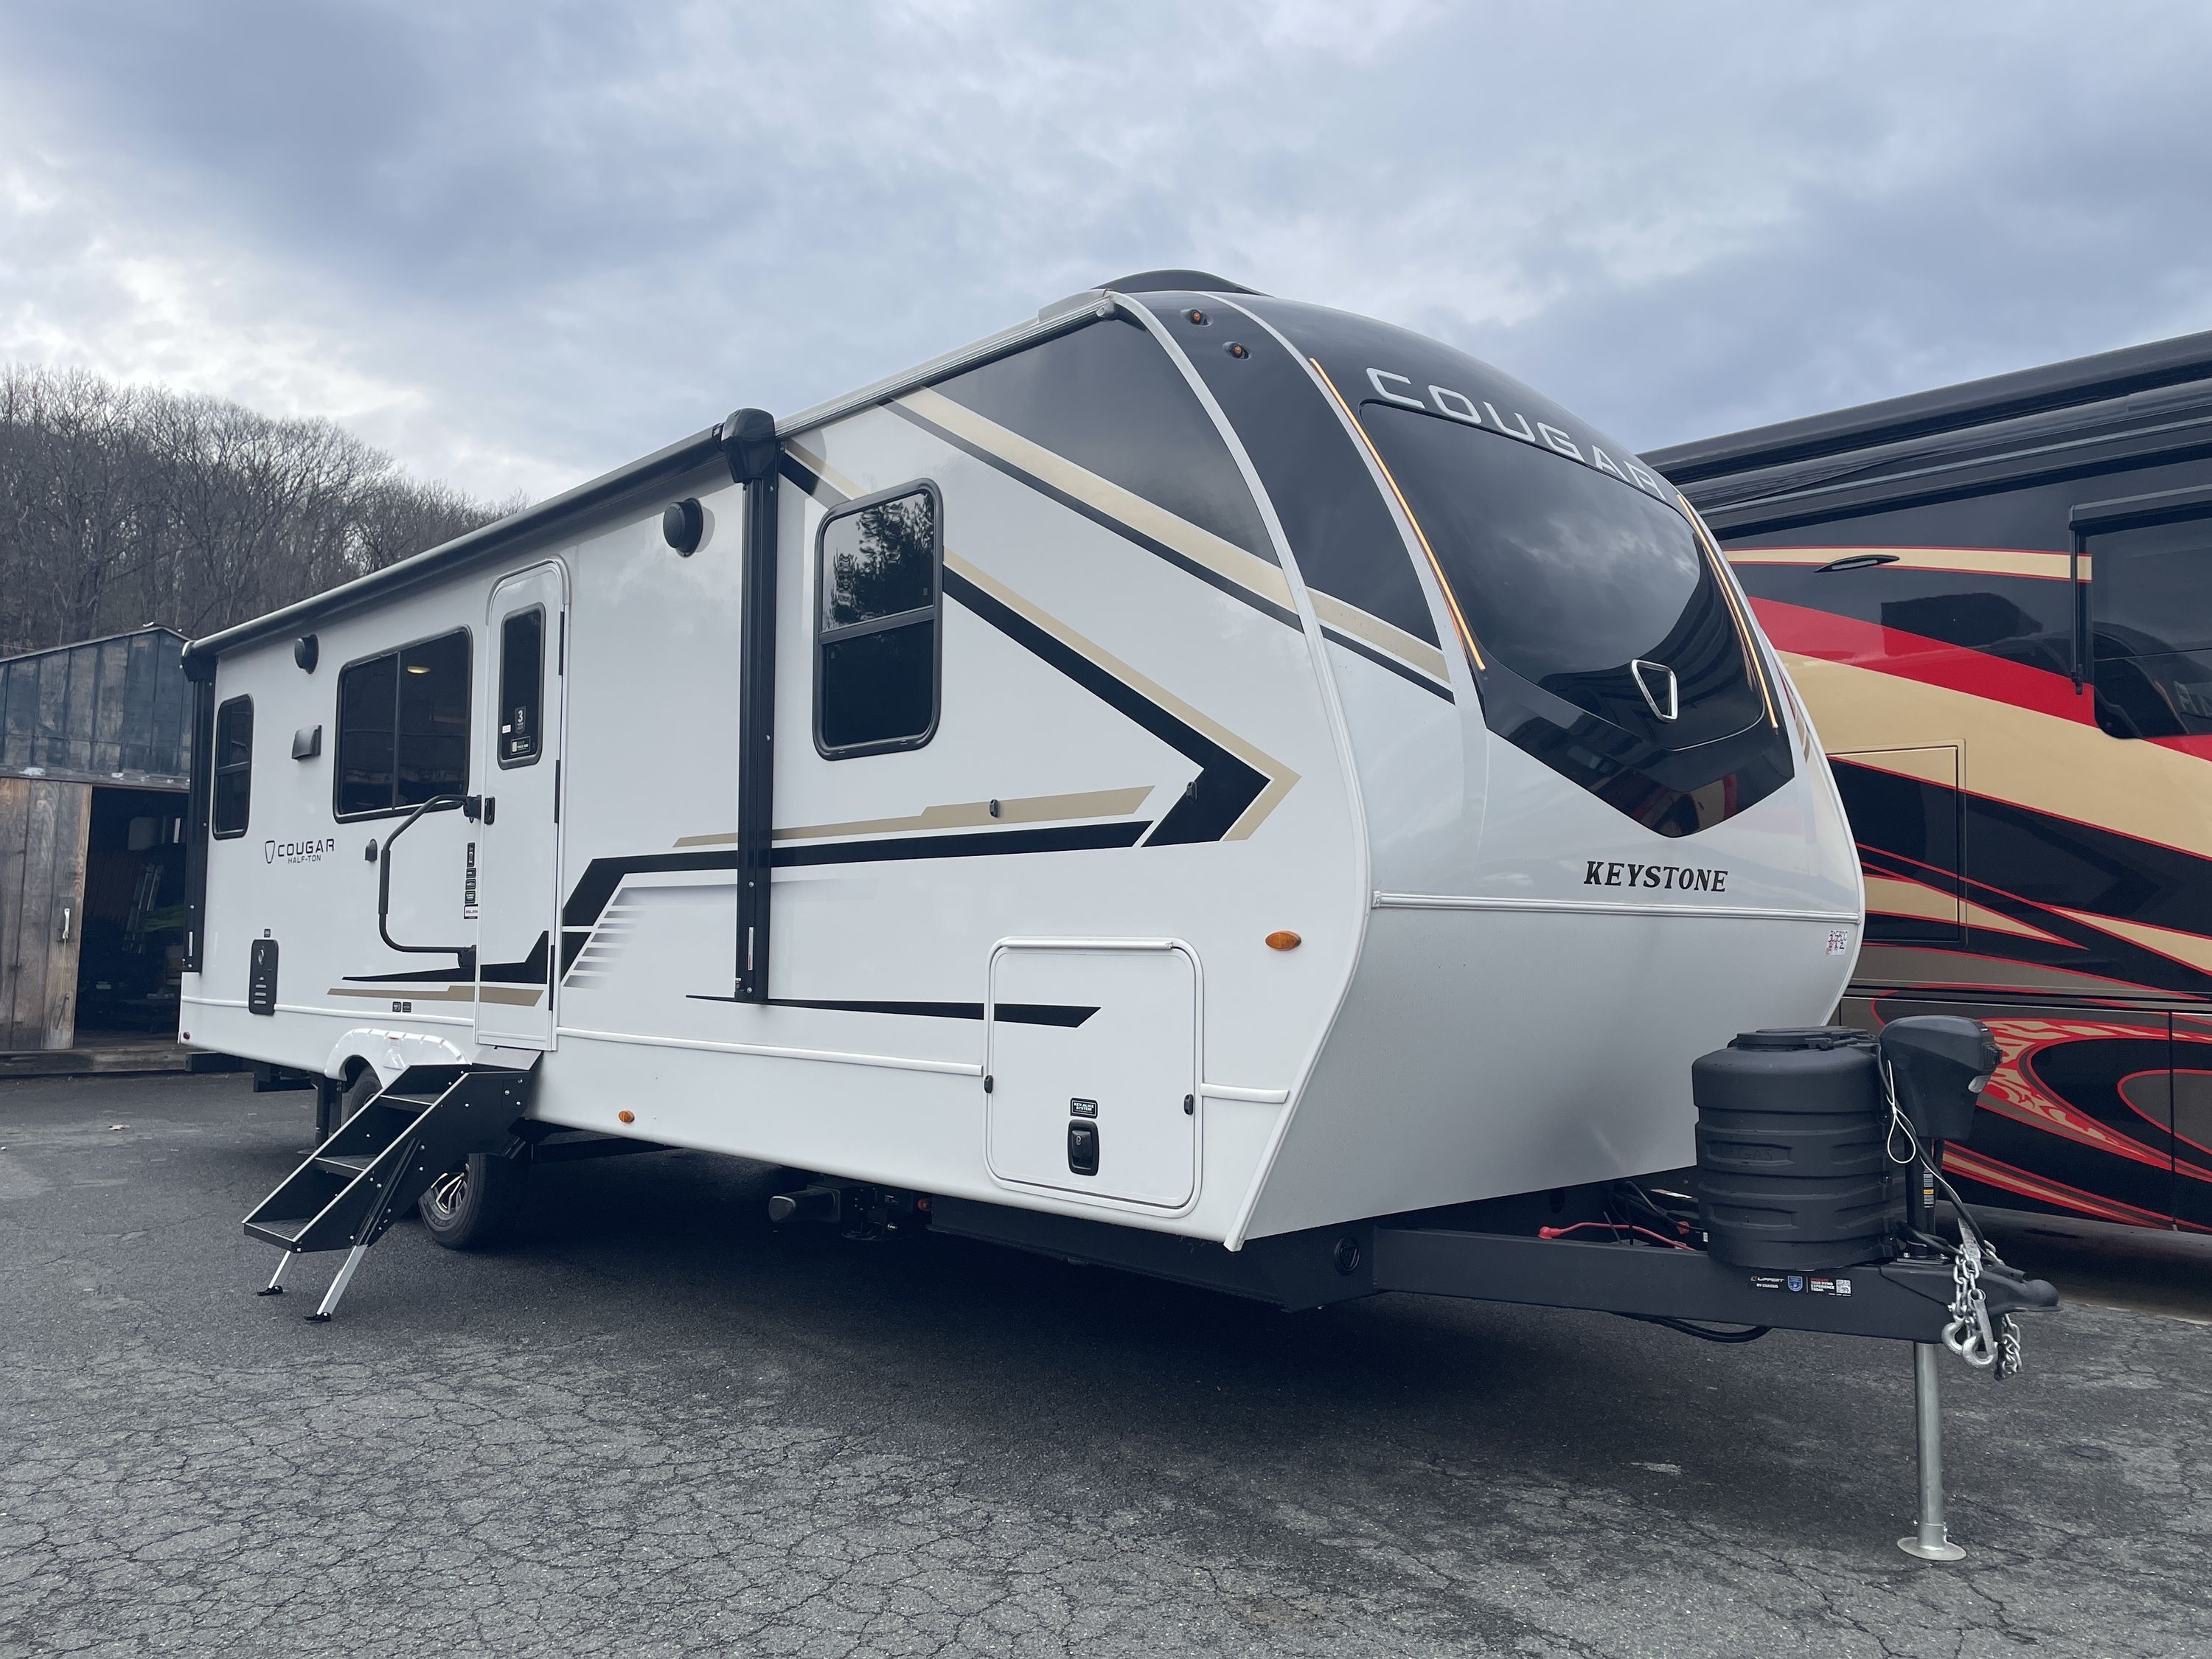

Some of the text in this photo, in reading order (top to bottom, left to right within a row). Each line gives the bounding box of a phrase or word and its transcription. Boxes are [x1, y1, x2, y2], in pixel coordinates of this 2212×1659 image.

[1366, 367, 1666, 501] COUGAR
[277, 838, 335, 858] COUGAR
[288, 854, 321, 864] HALF-TON
[1583, 860, 1728, 893] KEYSTONE
